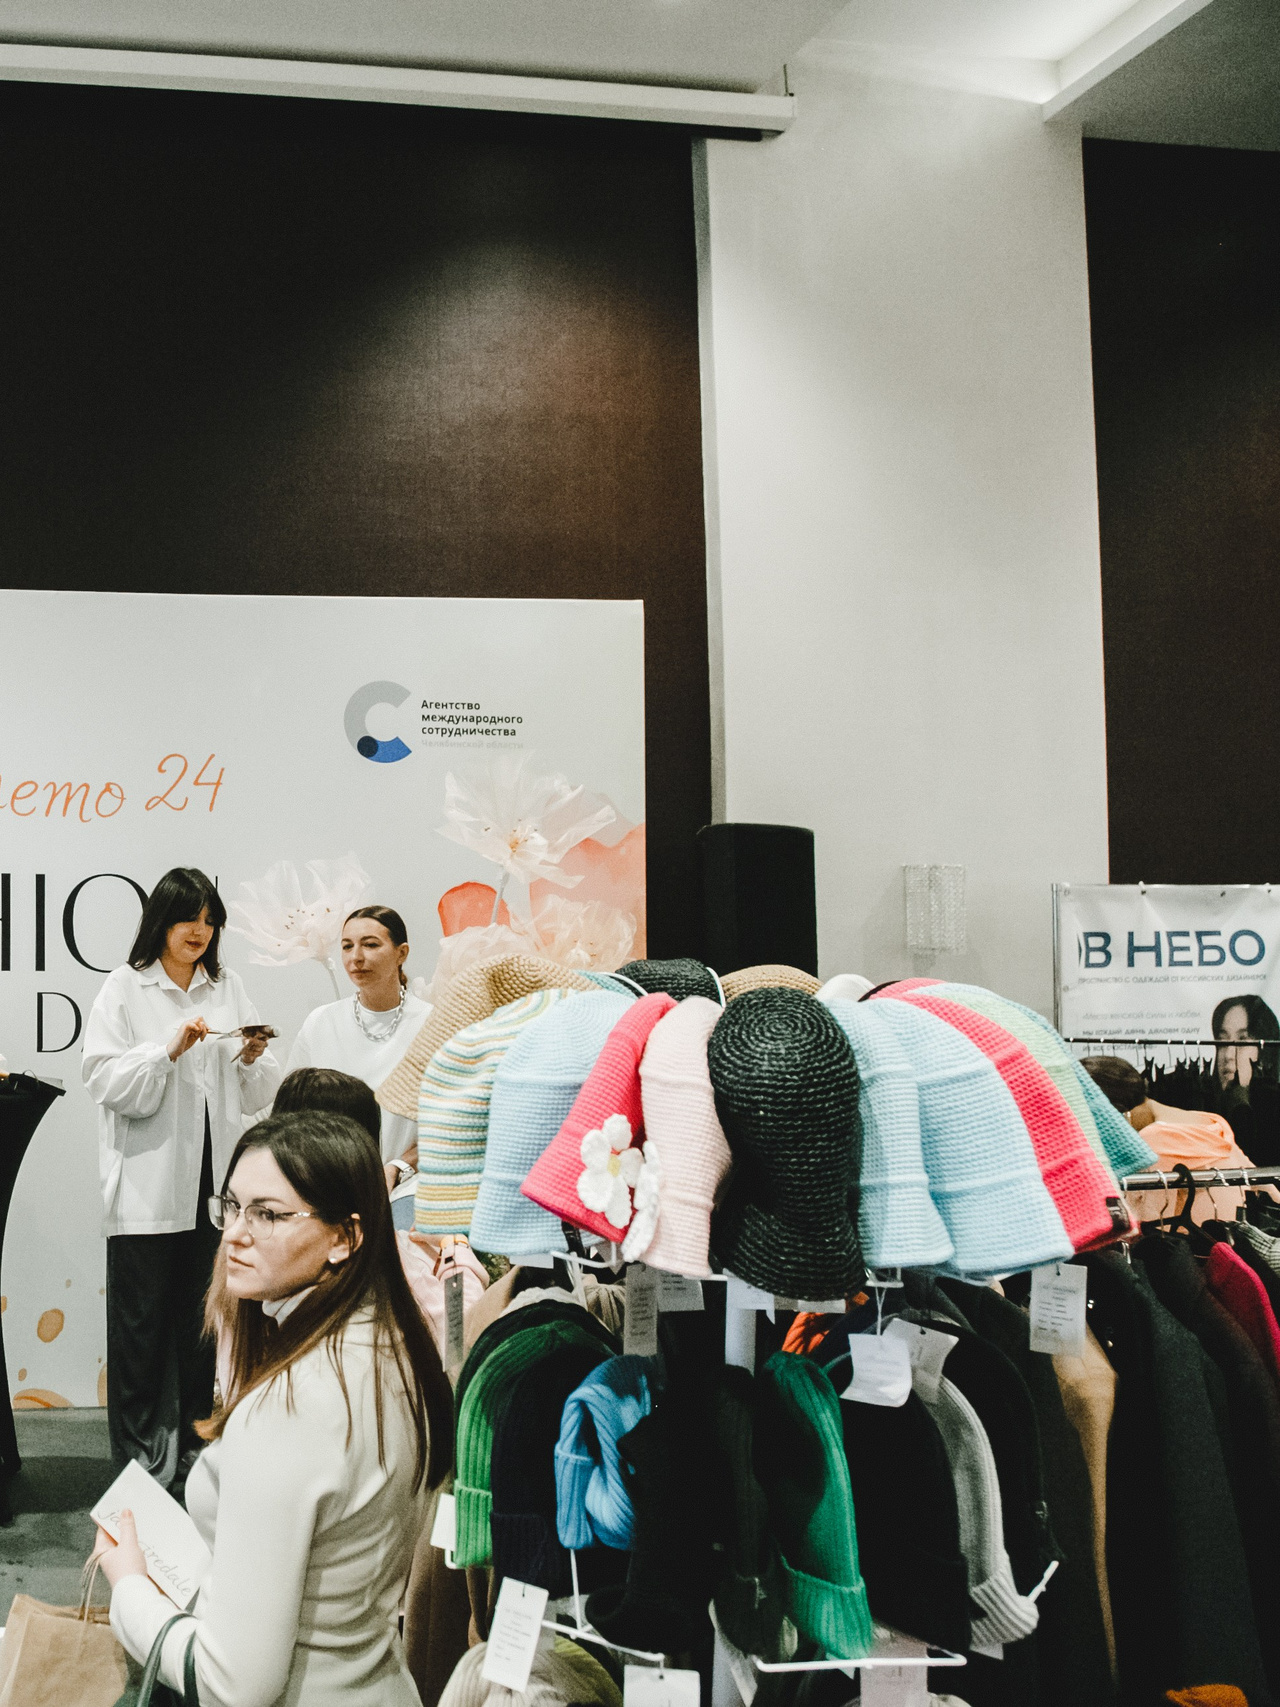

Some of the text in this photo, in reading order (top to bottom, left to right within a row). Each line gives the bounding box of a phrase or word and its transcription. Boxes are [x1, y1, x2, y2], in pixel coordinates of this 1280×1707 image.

[421, 699, 480, 710] Агентство
[422, 714, 523, 725] международного
[422, 726, 517, 738] сотрудничества
[422, 739, 523, 749] Челябинской области
[144, 753, 225, 812] 24
[1127, 929, 1266, 968] НЕБО
